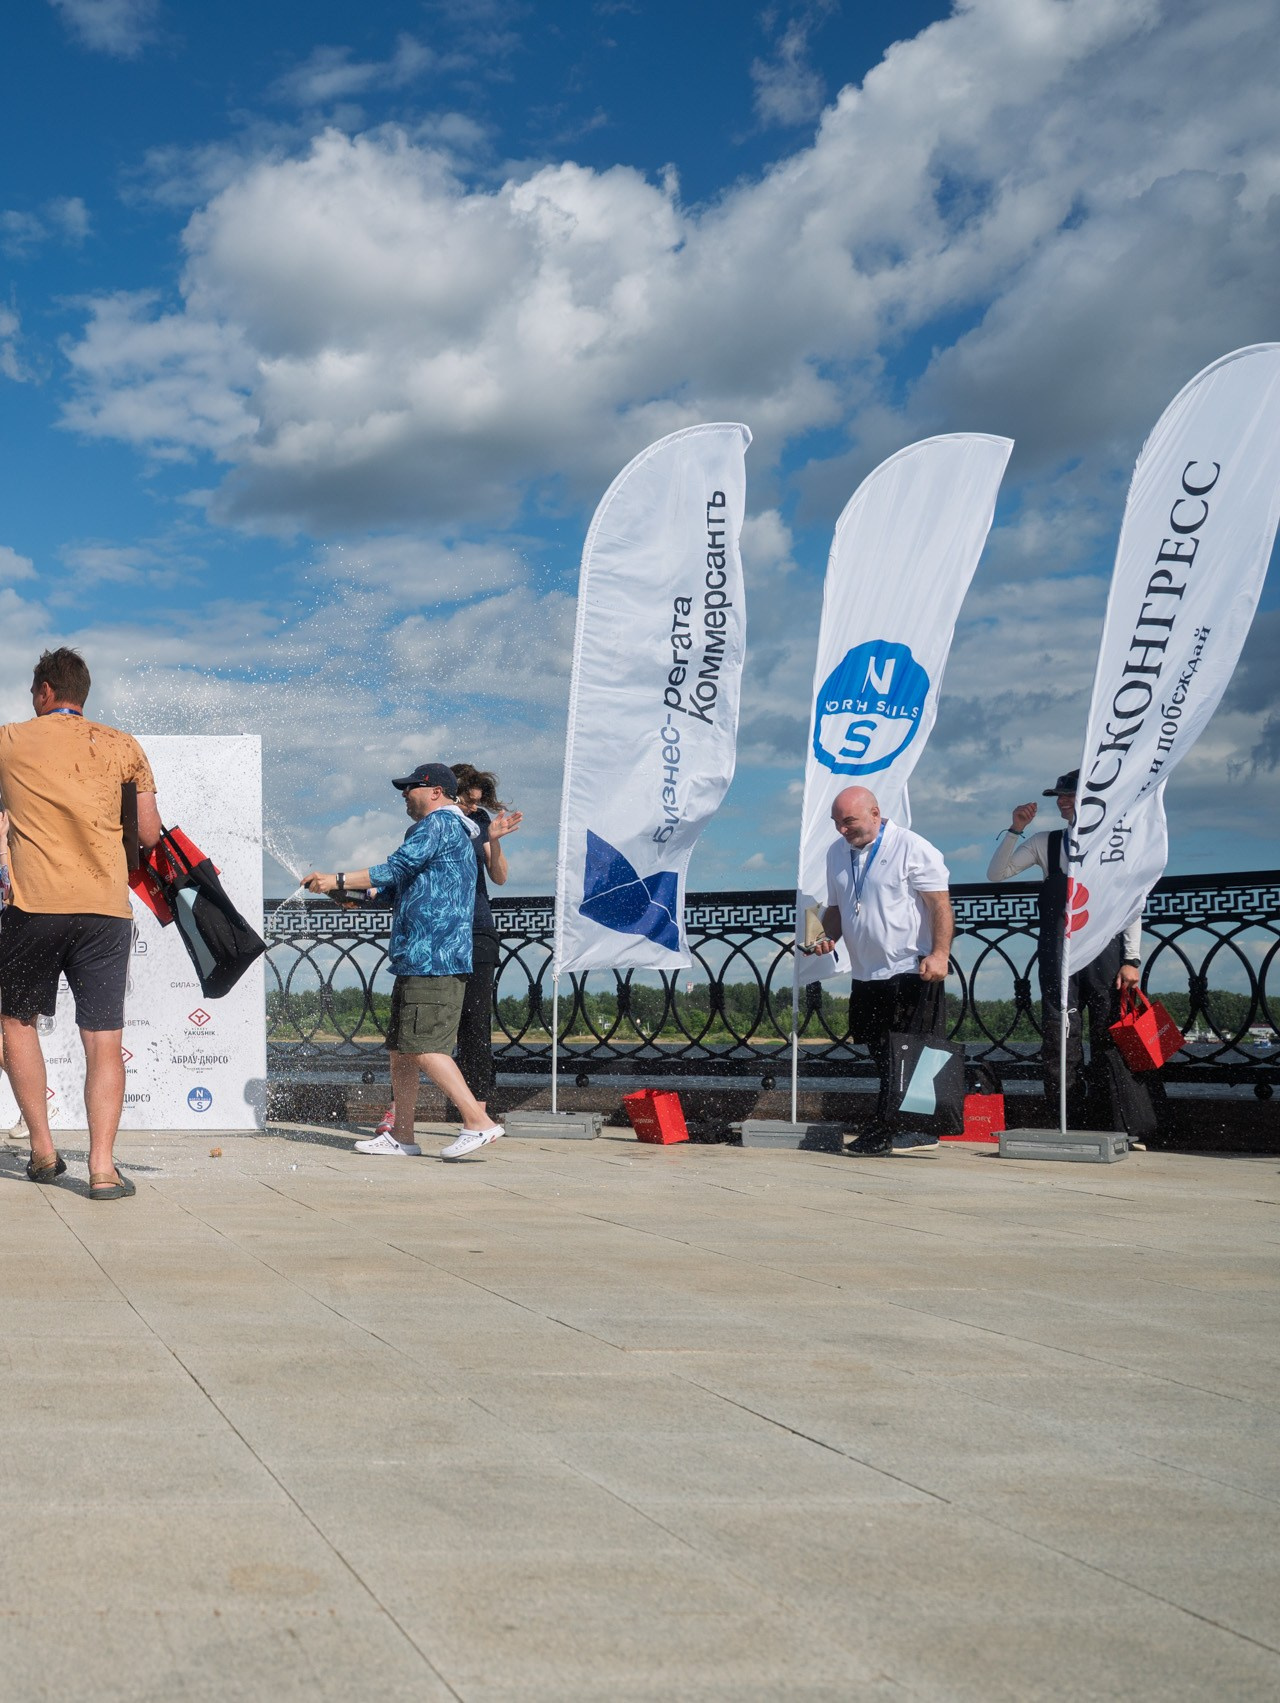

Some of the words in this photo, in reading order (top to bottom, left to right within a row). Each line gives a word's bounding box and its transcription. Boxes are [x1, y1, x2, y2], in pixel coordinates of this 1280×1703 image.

[688, 490, 732, 725] Коммерсантъ
[861, 656, 896, 695] N
[1157, 626, 1211, 753] побеждай
[825, 699, 868, 713] NORH
[839, 720, 878, 759] S
[196, 1089, 204, 1098] N
[196, 1101, 203, 1110] S
